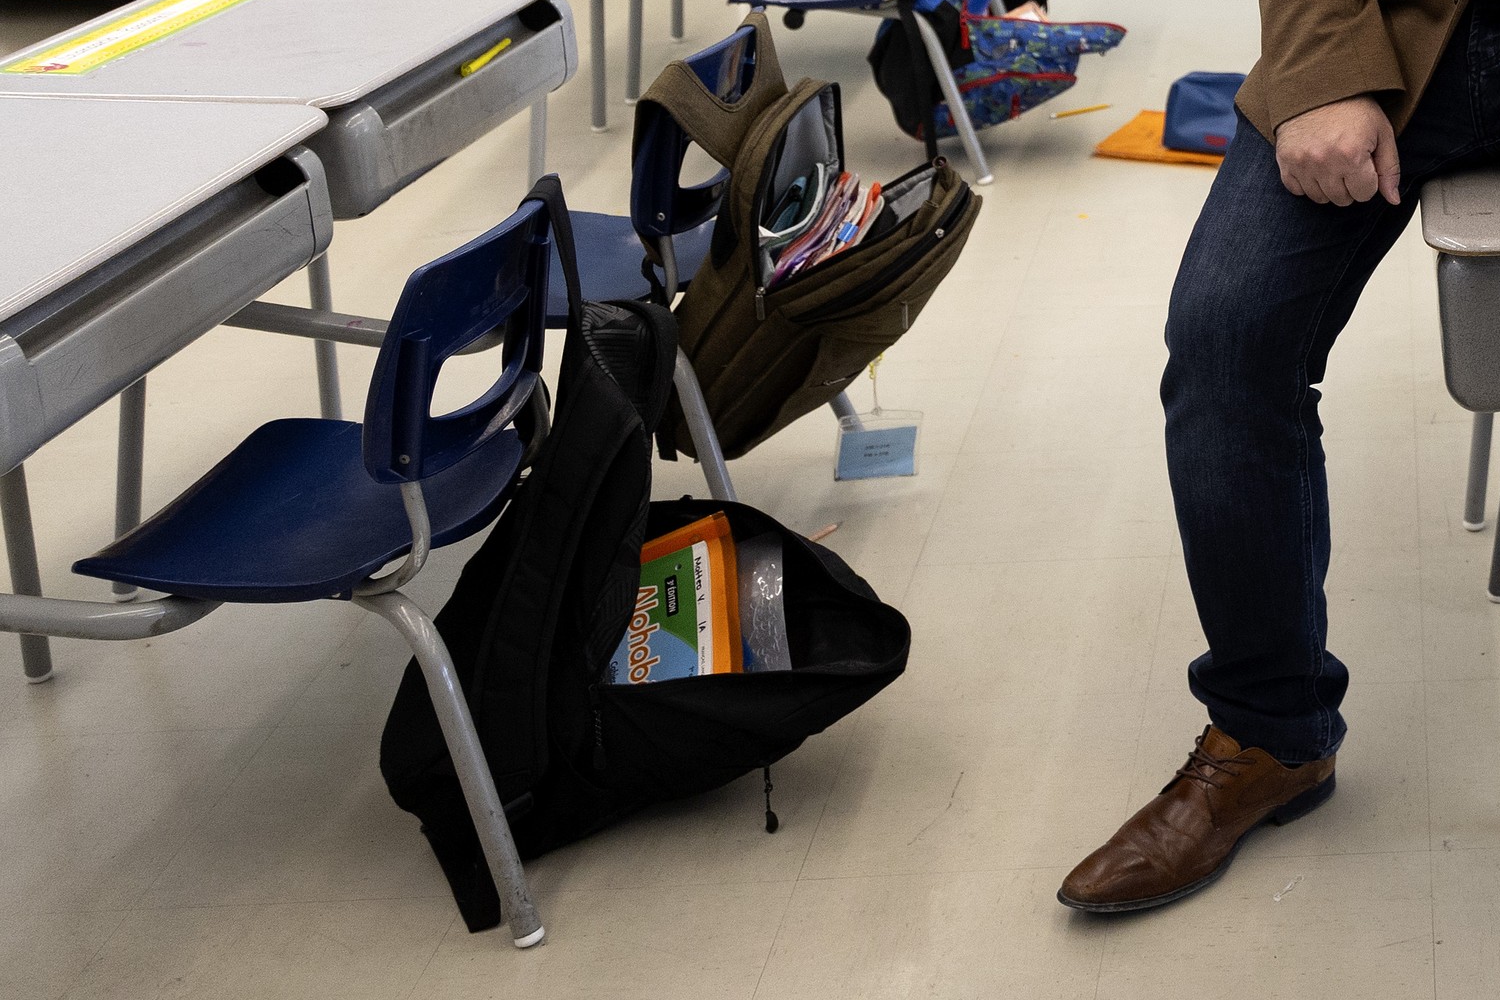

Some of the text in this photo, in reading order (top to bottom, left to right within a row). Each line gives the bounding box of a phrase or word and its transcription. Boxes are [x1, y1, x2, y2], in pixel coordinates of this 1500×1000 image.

[693, 556, 703, 590] Matteo
[664, 587, 677, 613] ÉDITION
[628, 585, 661, 685] Alphab
